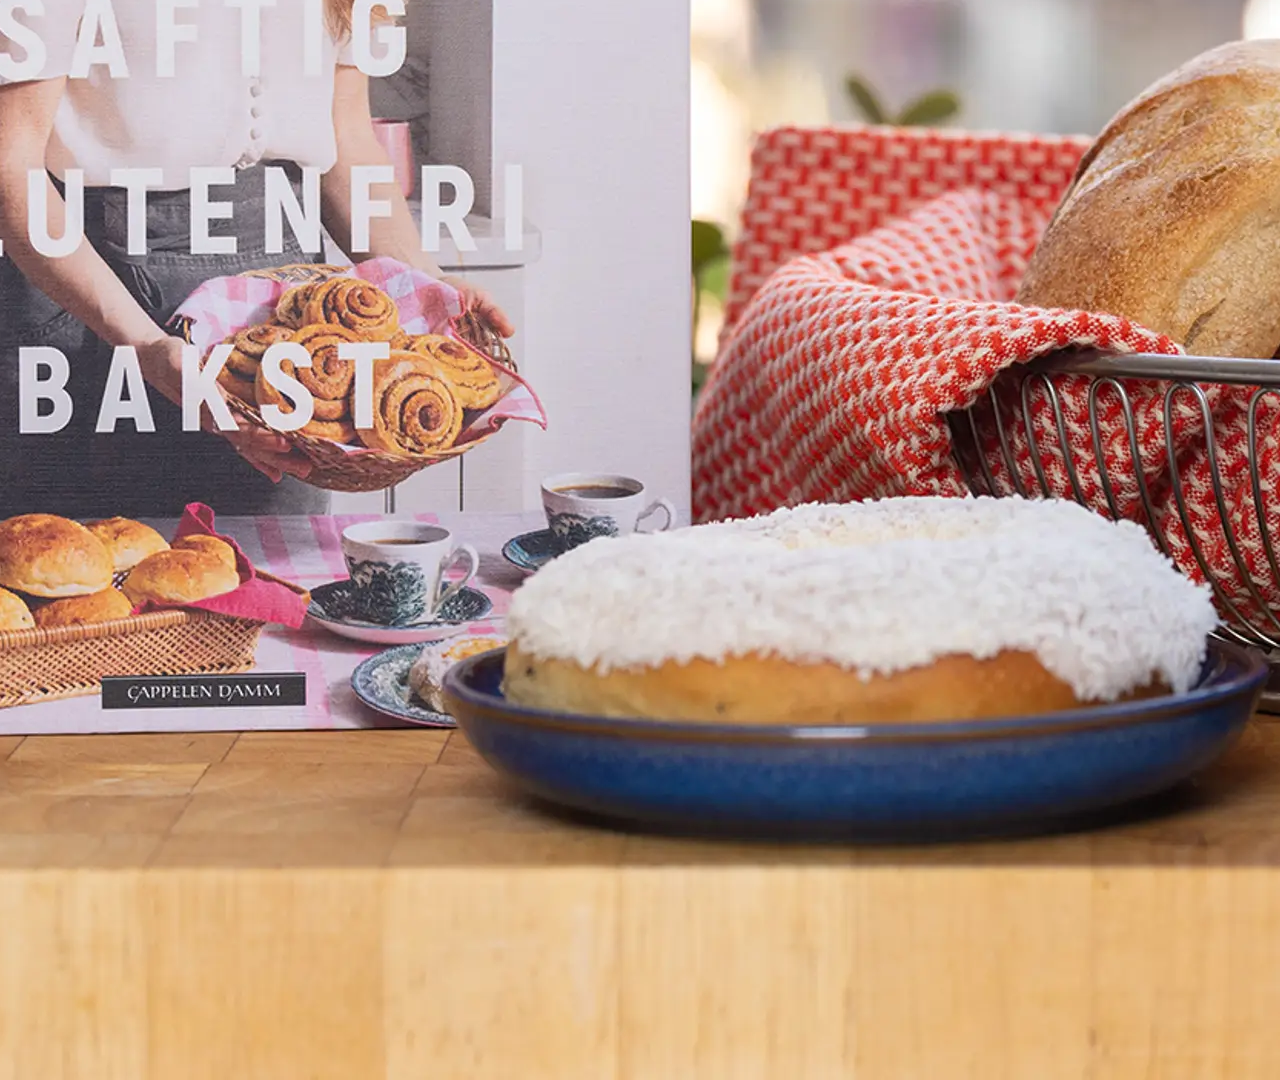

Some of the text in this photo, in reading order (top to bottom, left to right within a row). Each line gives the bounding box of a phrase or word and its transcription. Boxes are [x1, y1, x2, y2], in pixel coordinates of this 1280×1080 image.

[18, 341, 391, 435] BAKST
[127, 683, 281, 703] CAPPELEN DAMM
